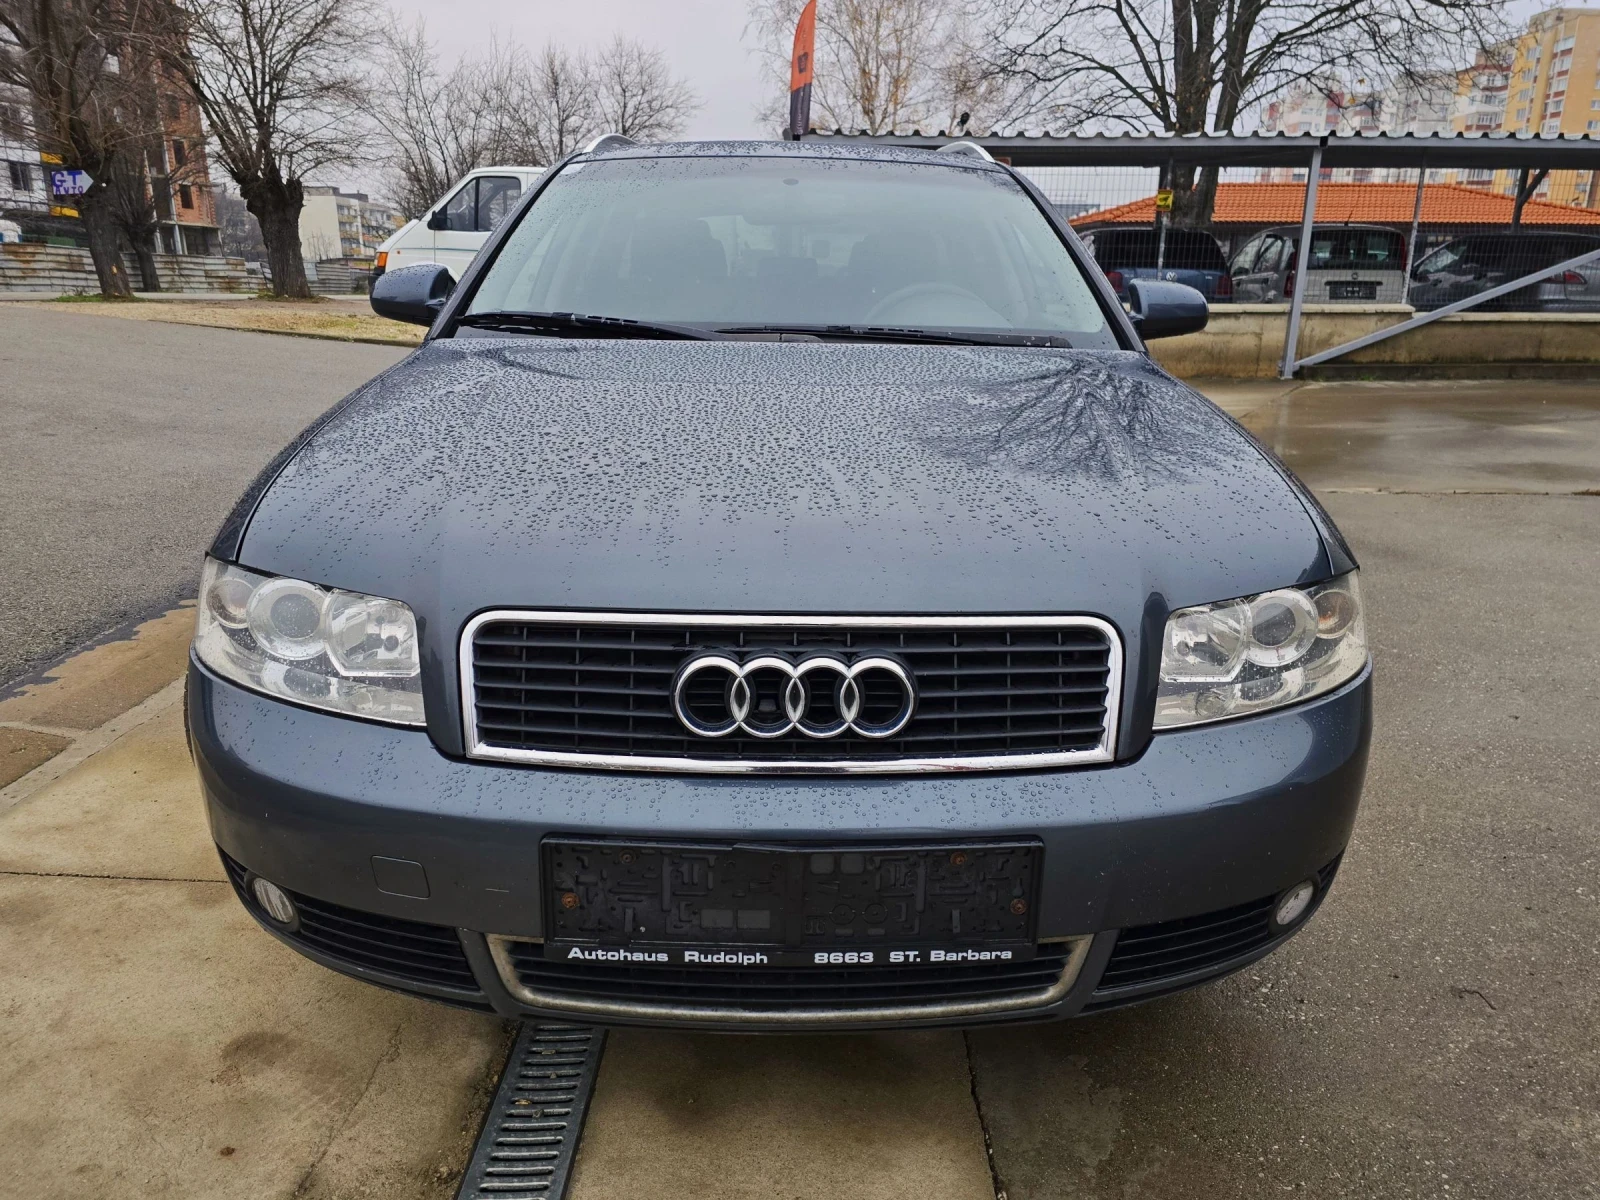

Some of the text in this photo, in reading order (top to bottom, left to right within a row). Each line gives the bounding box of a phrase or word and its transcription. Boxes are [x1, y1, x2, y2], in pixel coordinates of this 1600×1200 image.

[52, 170, 82, 187] GT
[567, 947, 1012, 966] Autohaus Rudolph 8663 ST. Barbara
